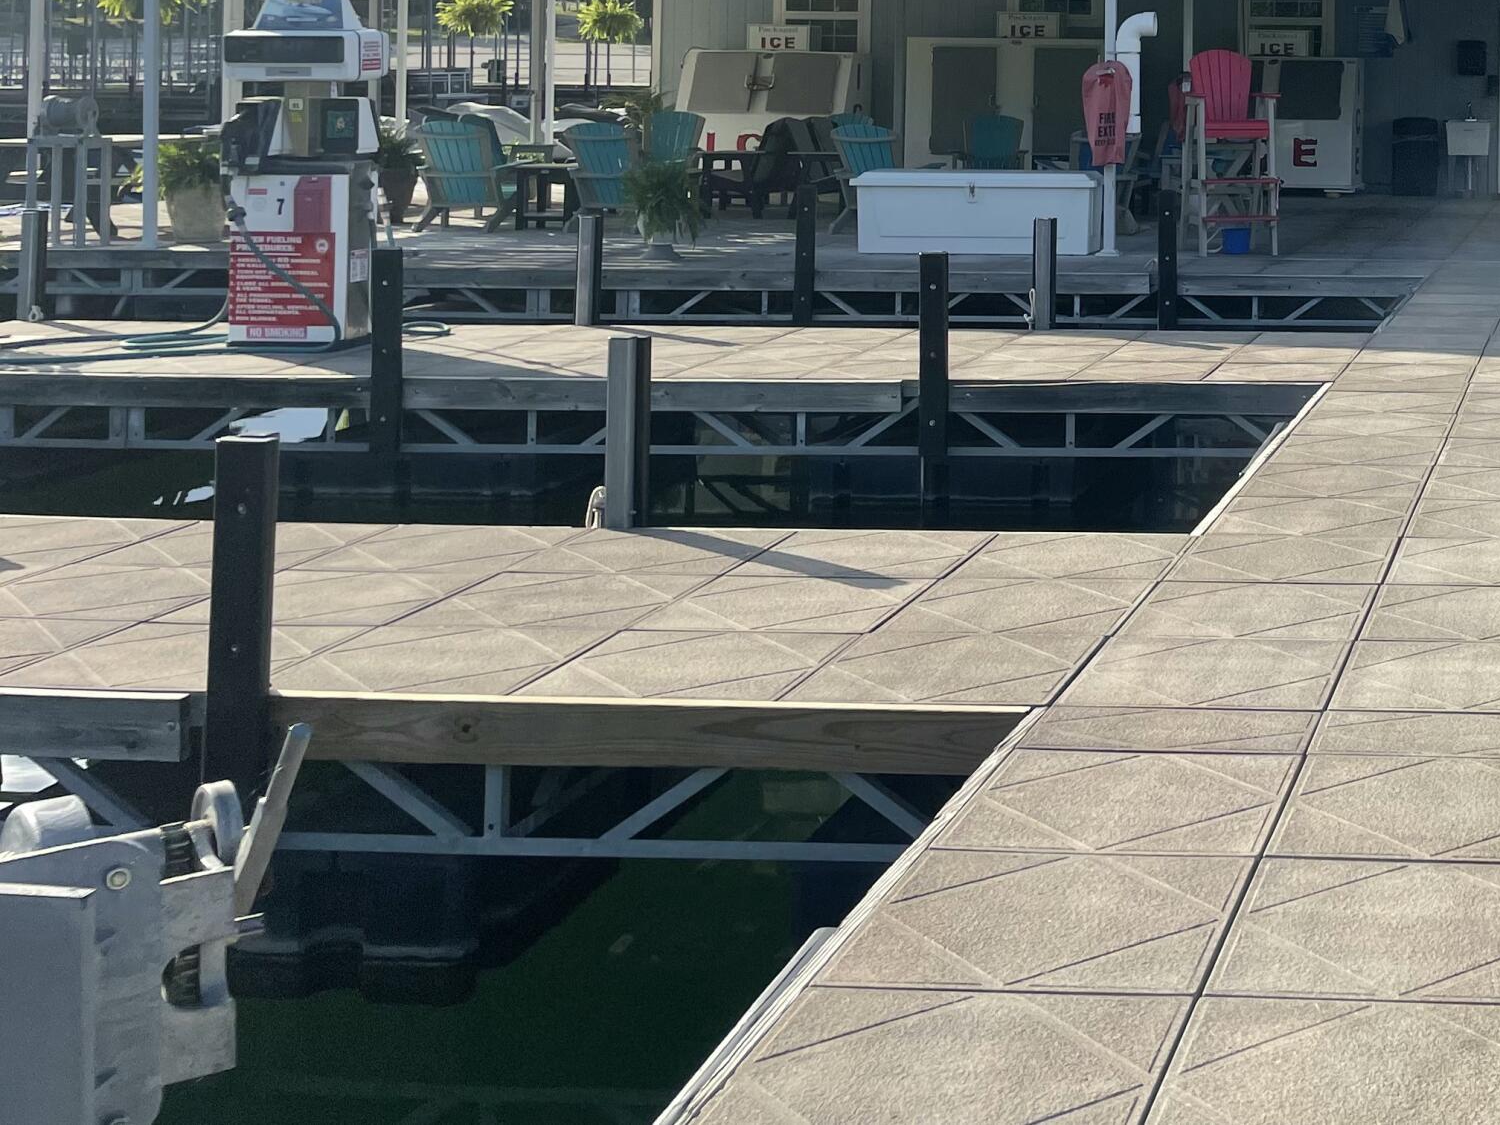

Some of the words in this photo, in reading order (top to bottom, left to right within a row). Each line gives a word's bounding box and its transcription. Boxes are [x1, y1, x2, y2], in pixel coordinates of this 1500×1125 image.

[1010, 25, 1045, 37] ICE
[761, 37, 795, 49] ICE
[1260, 43, 1295, 55] ICE
[276, 198, 285, 215] 7
[249, 327, 262, 338] NO
[264, 327, 306, 338] SMOKING
